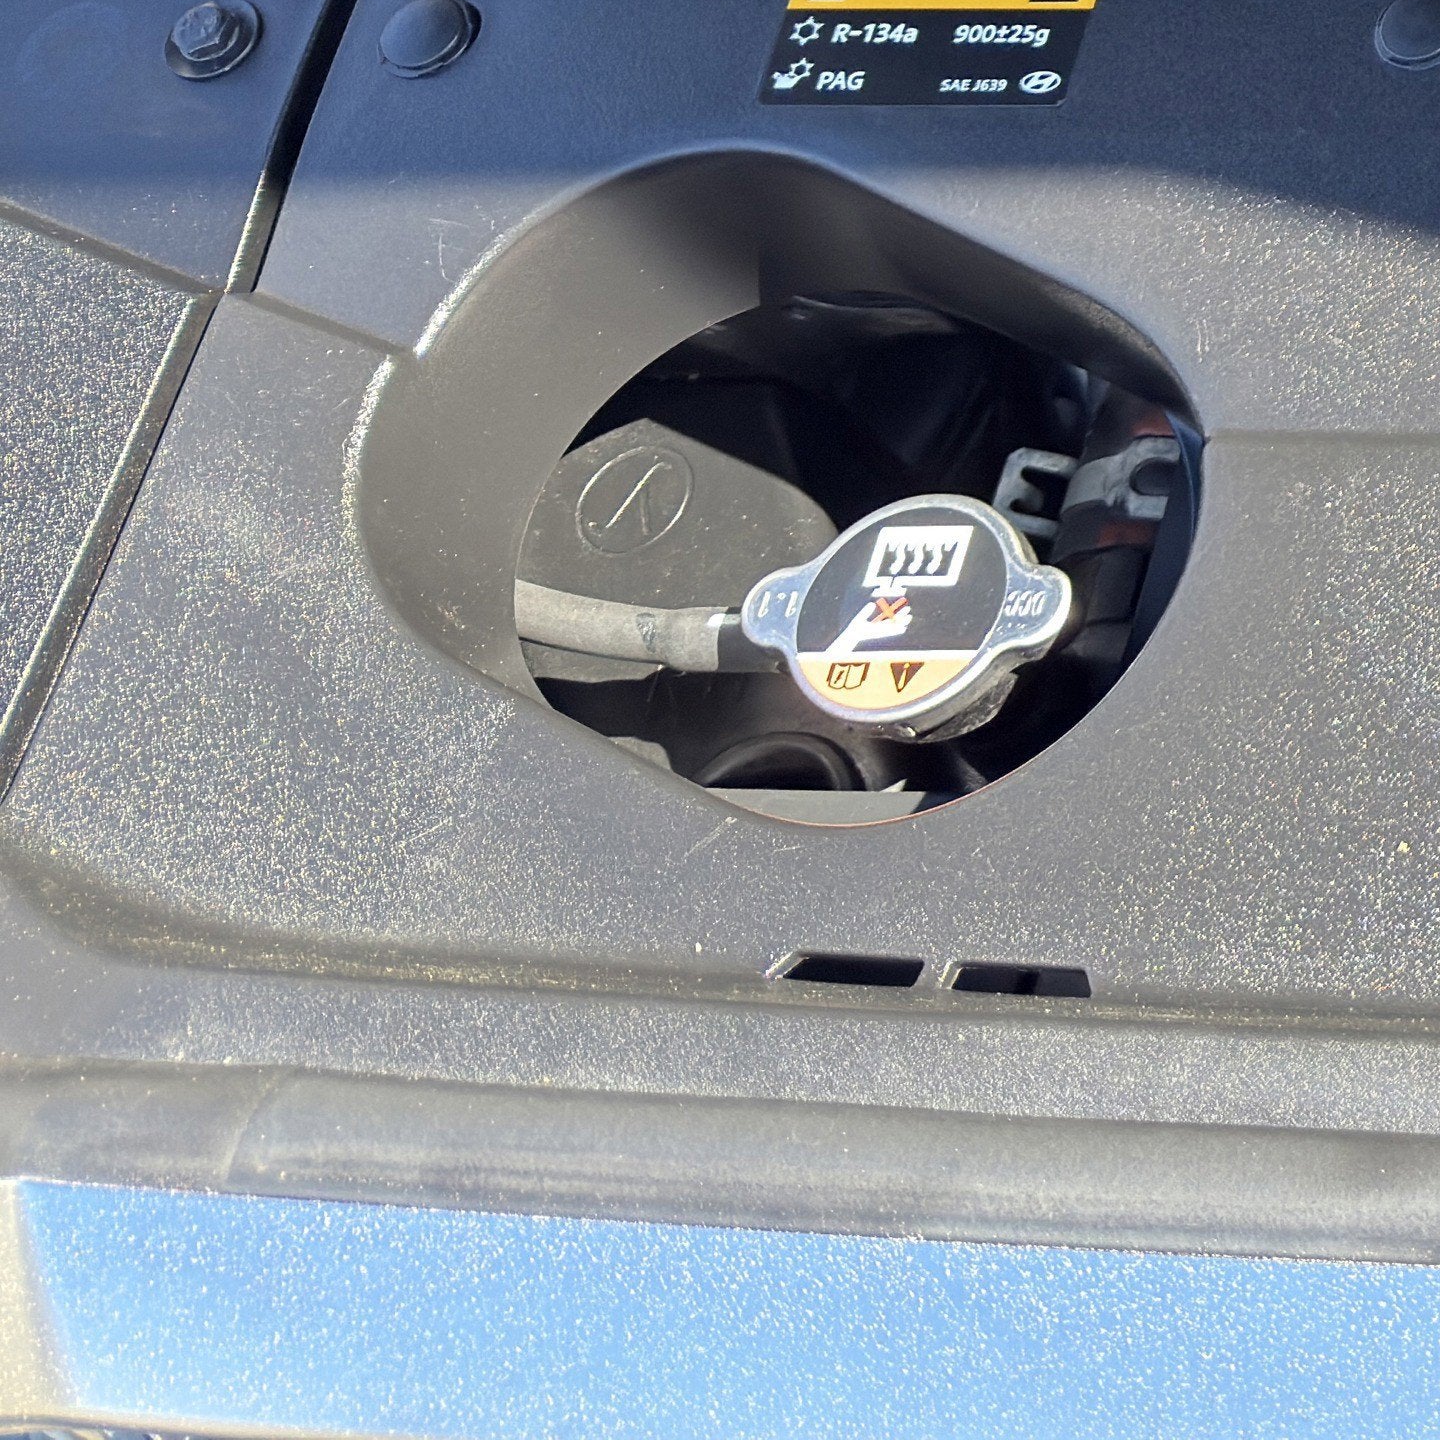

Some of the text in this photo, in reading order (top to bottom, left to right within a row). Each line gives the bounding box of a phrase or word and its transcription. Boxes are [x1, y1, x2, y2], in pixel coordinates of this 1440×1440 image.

[829, 22, 1051, 49] R-134a 900±25g
[815, 70, 1008, 92] PAG SAE J639
